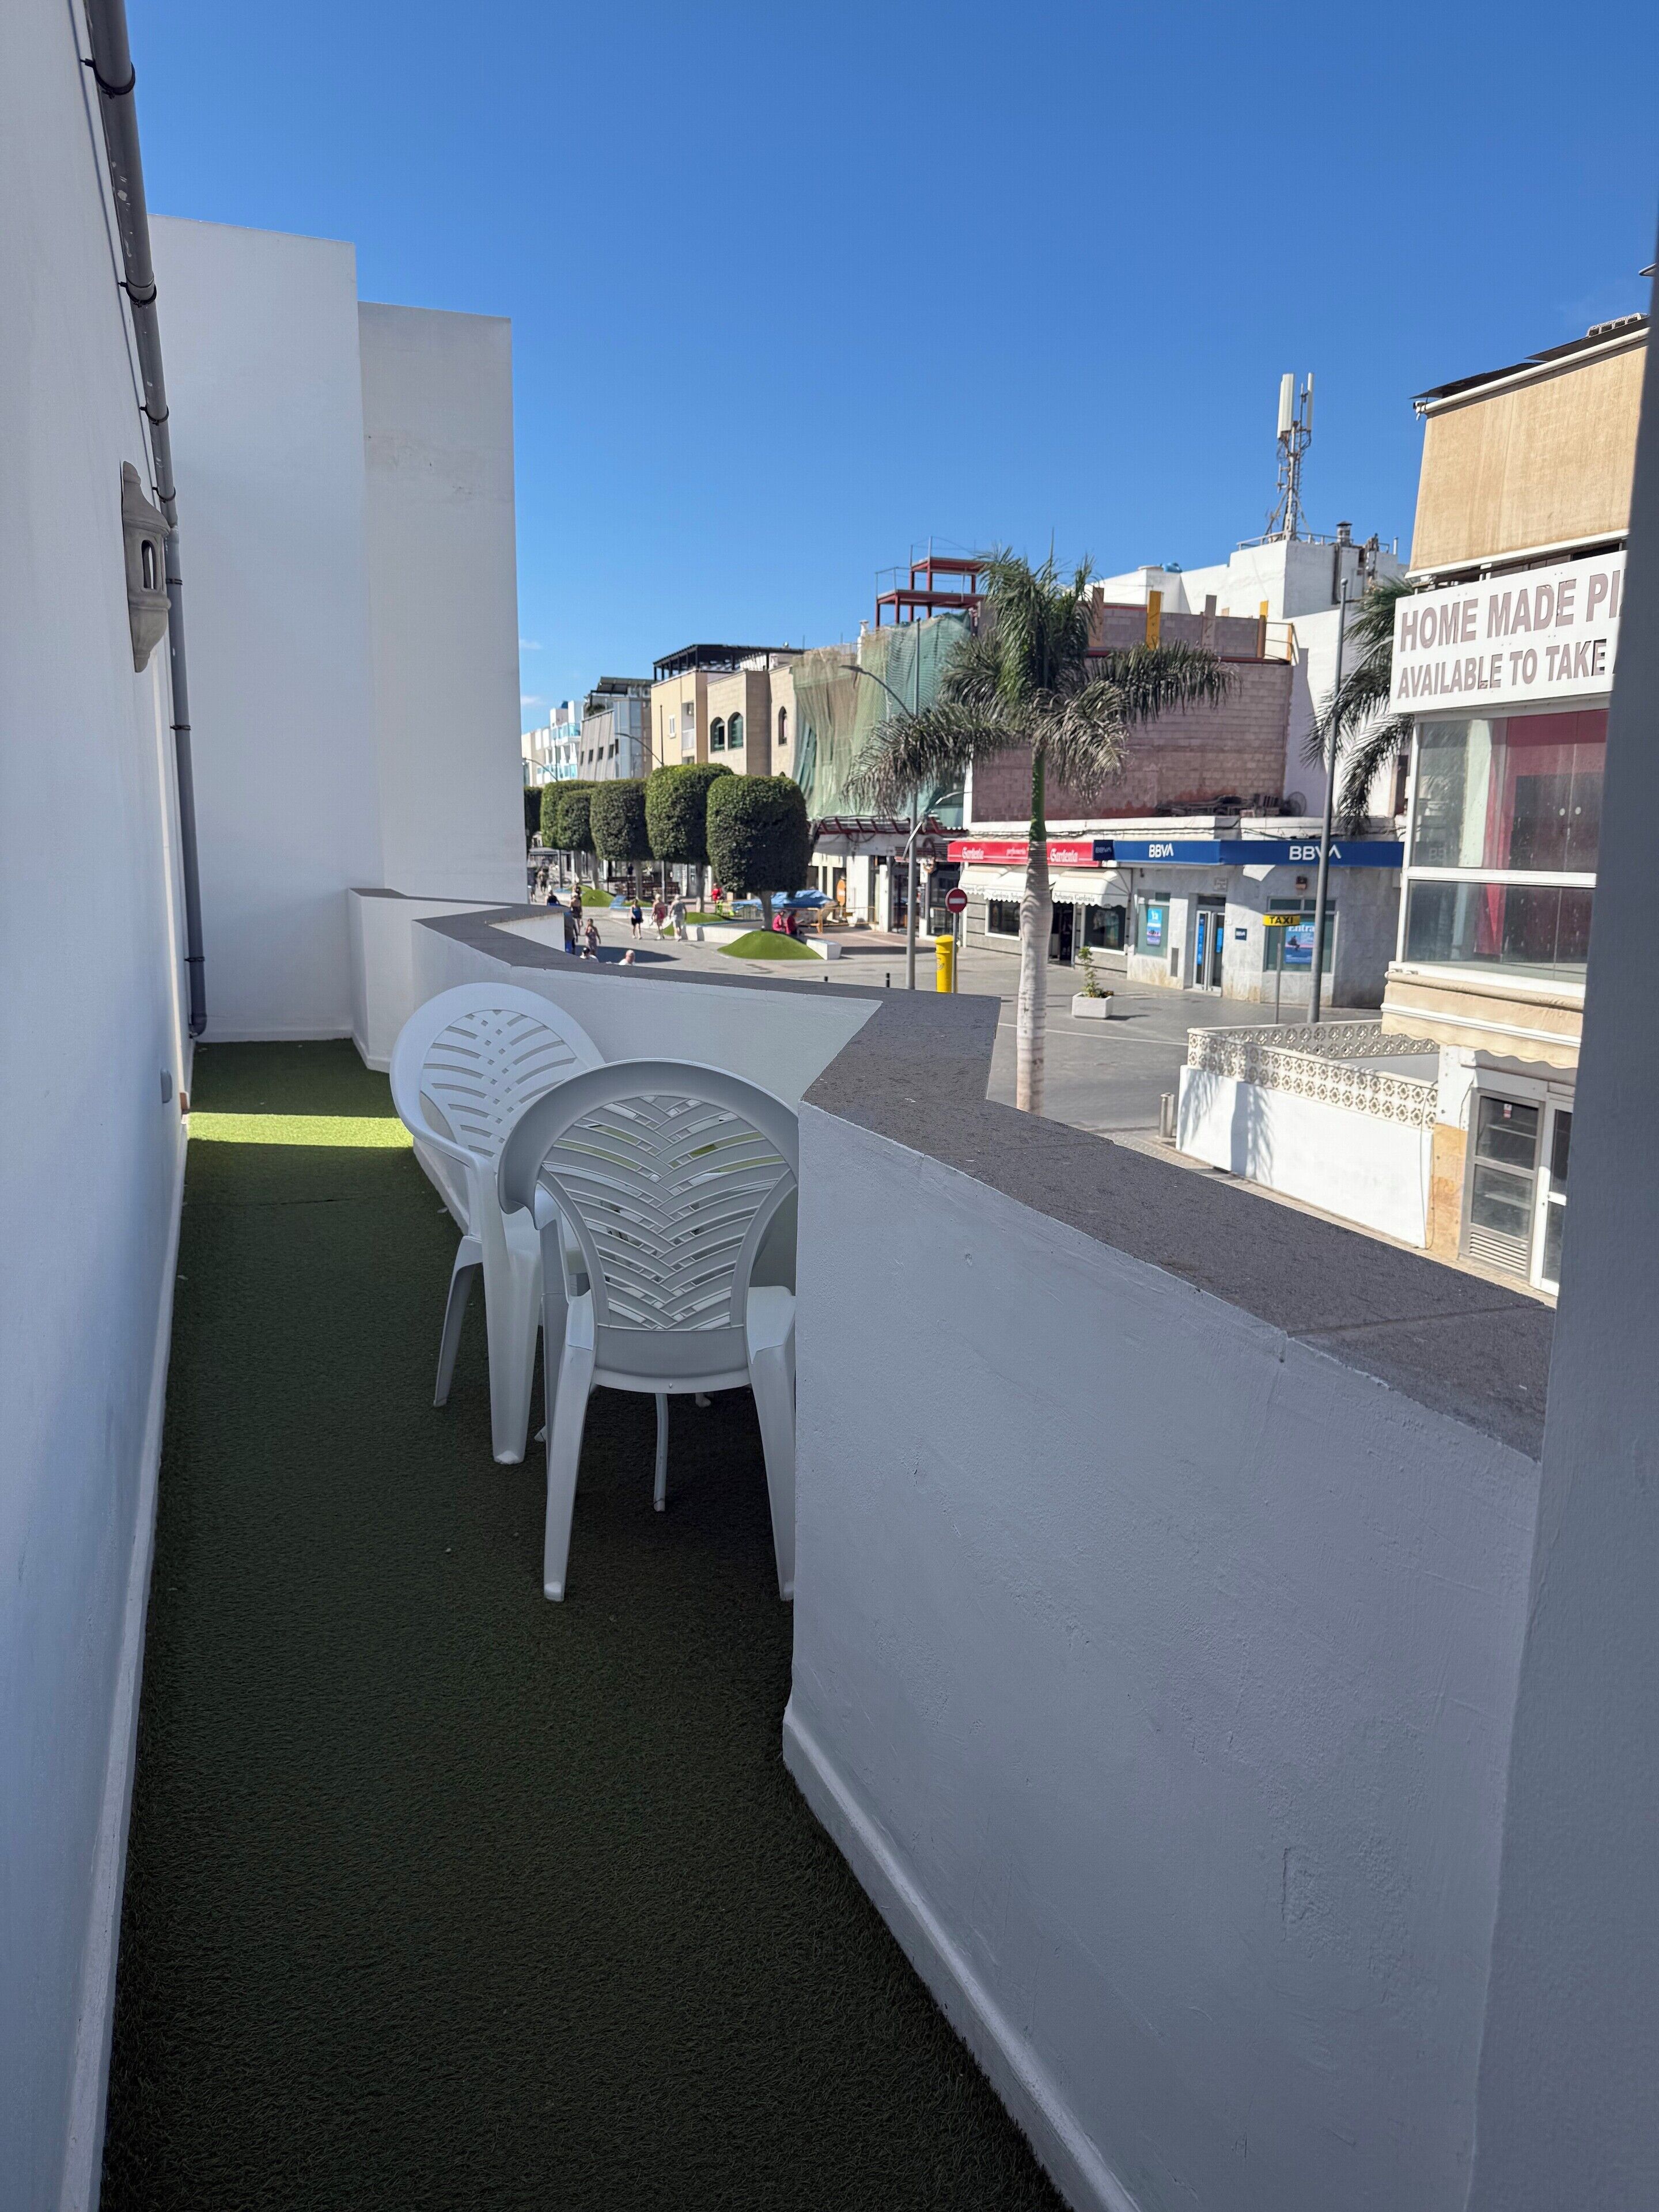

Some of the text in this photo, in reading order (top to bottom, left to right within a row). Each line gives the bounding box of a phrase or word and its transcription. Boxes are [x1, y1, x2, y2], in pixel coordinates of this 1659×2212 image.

[1400, 569, 1626, 652] HOME MADE PI
[1397, 638, 1607, 699] AVAILABLE TO TAKE
[1050, 847, 1078, 862] Gardenia
[1149, 843, 1174, 858] BBVA
